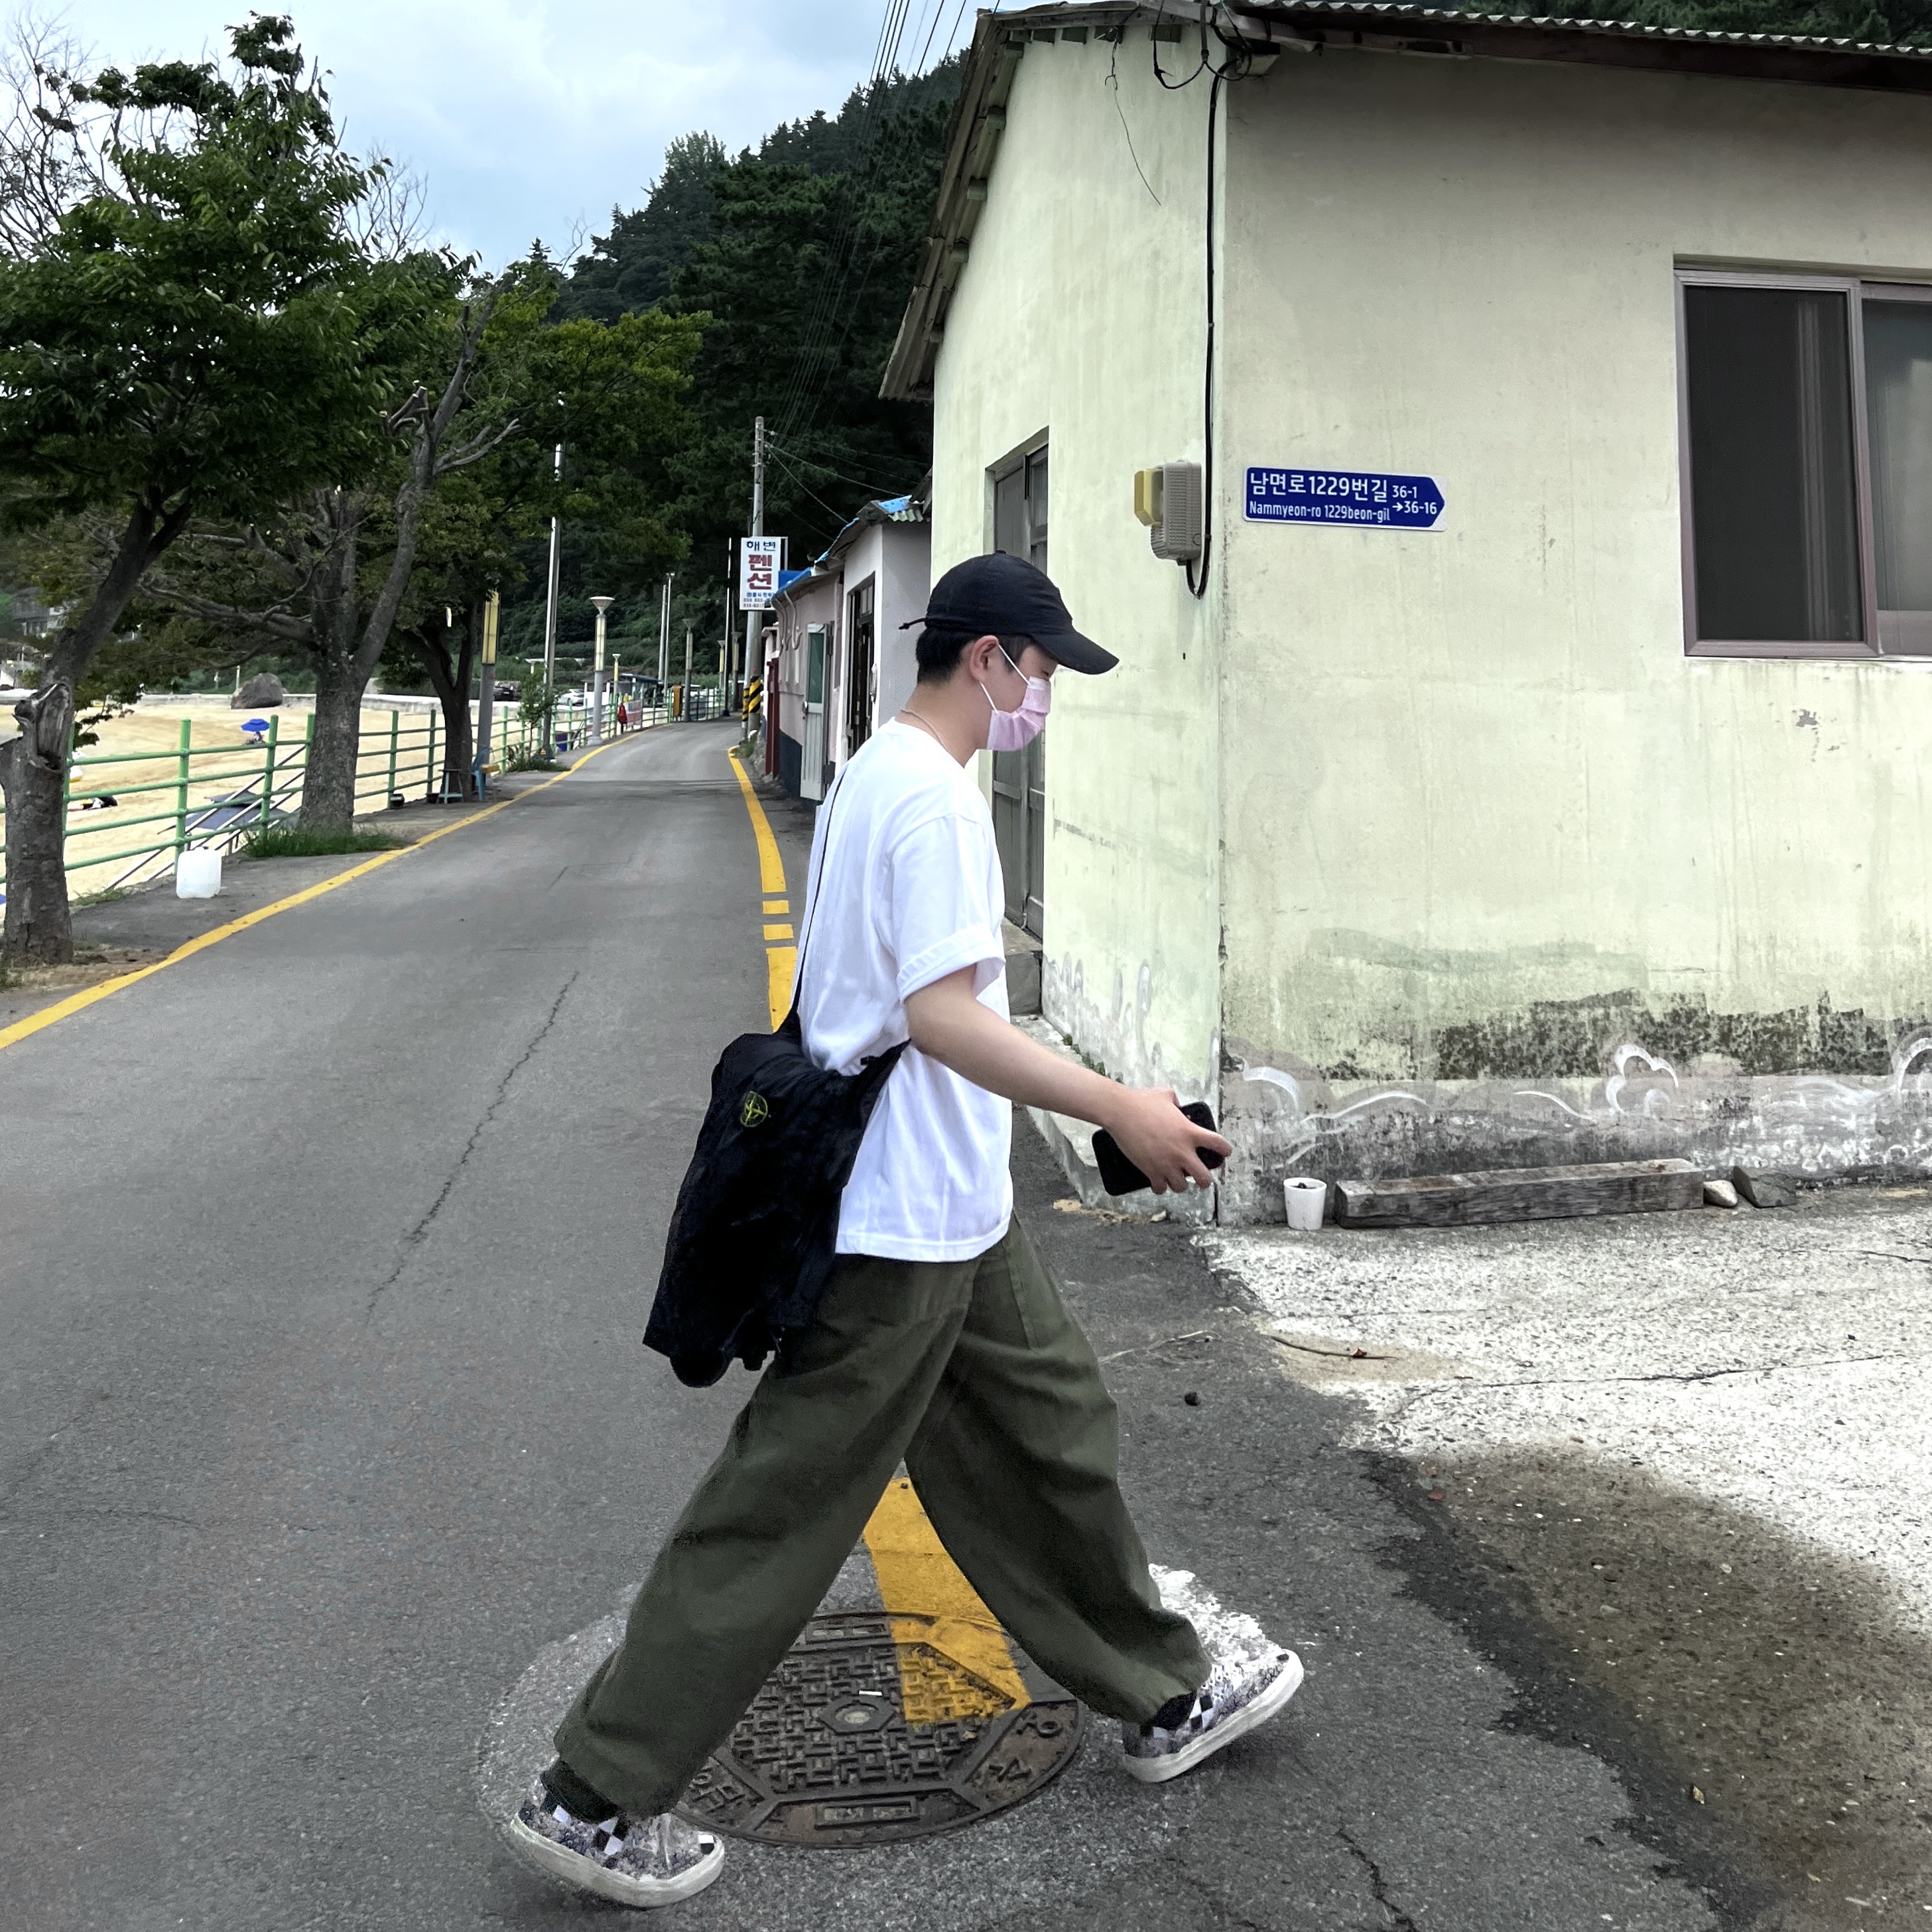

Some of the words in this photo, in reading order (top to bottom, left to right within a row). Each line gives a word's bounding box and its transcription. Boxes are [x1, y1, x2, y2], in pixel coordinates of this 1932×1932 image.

[1250, 472, 1387, 503] 남면로1229번길
[1392, 485, 1417, 499] 36-1
[1250, 501, 1321, 518] Nammyeon-ro
[1324, 505, 1391, 523] 1229beon-gil
[1404, 501, 1437, 515] 36-16
[747, 541, 775, 551] 해변
[747, 554, 772, 590] 펜션
